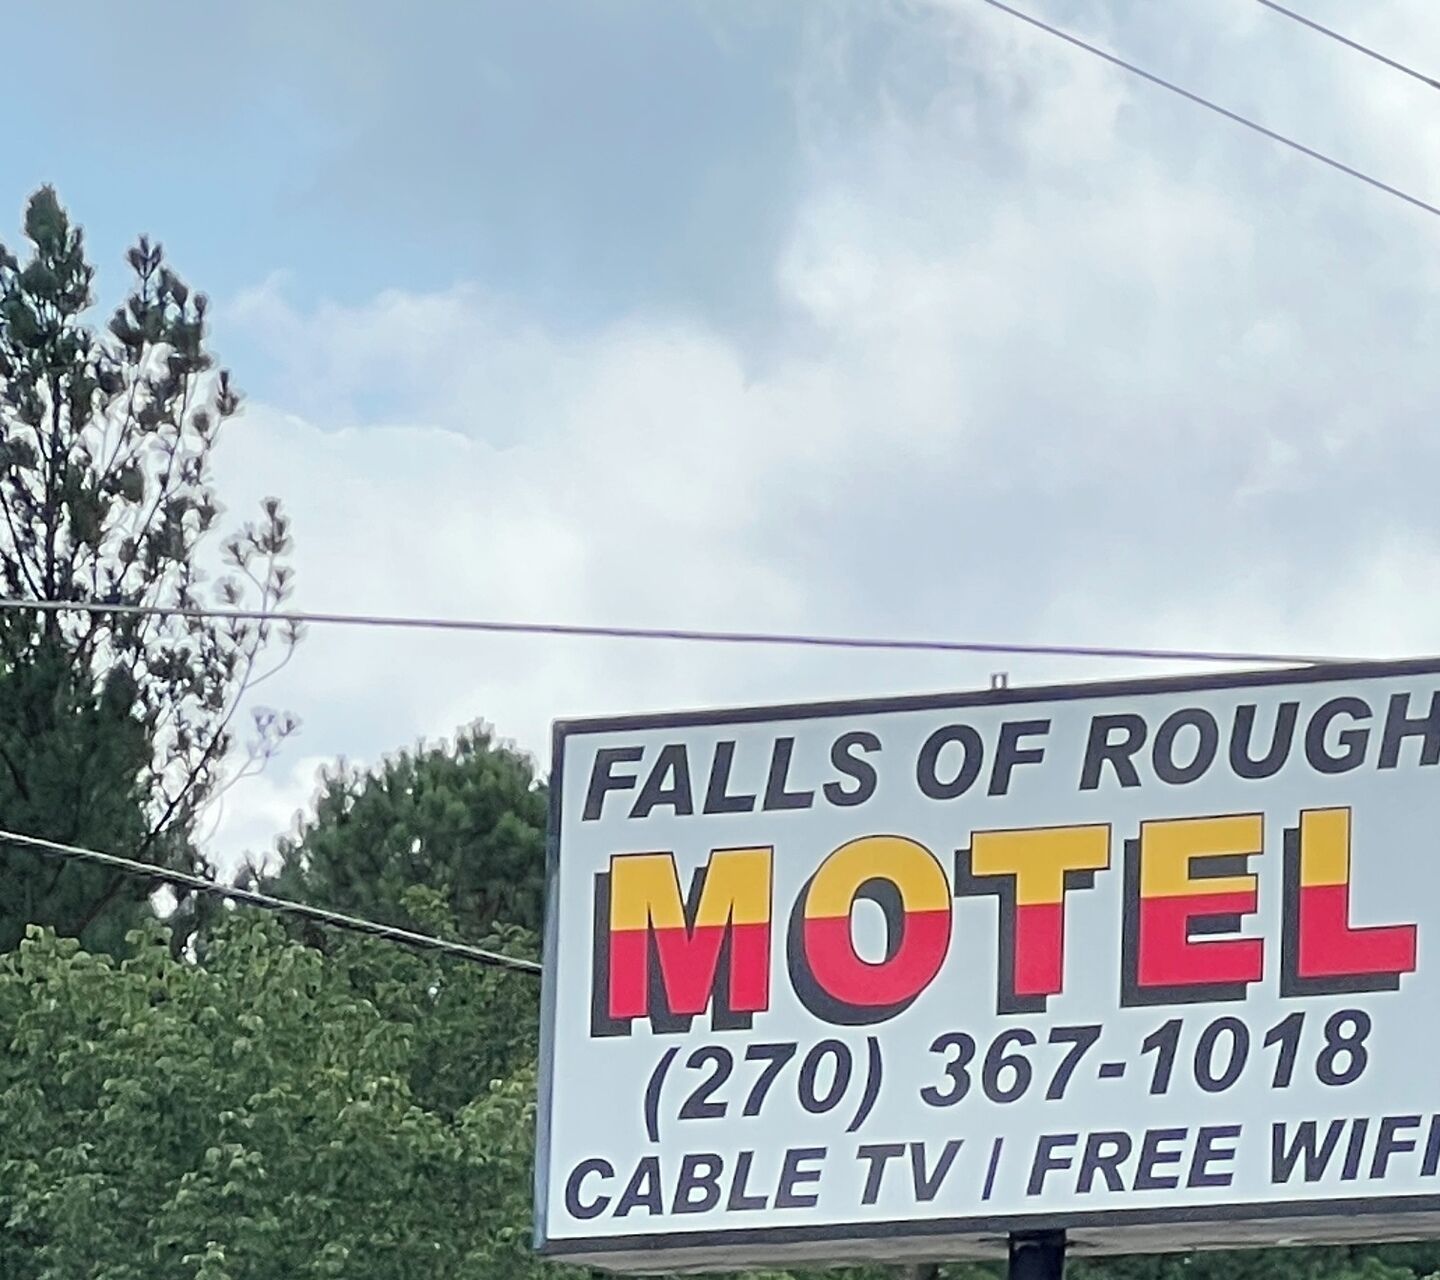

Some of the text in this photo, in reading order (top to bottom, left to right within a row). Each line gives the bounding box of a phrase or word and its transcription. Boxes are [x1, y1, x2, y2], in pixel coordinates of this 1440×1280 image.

[581, 731, 882, 822] FALLS
[916, 718, 1053, 800] OF
[590, 806, 1418, 1038] MOTEL
[644, 1009, 1372, 1143] (270) 367-1018
[565, 1147, 827, 1220] CABLE
[856, 1139, 964, 1205] TV
[1026, 1124, 1242, 1196] FREE
